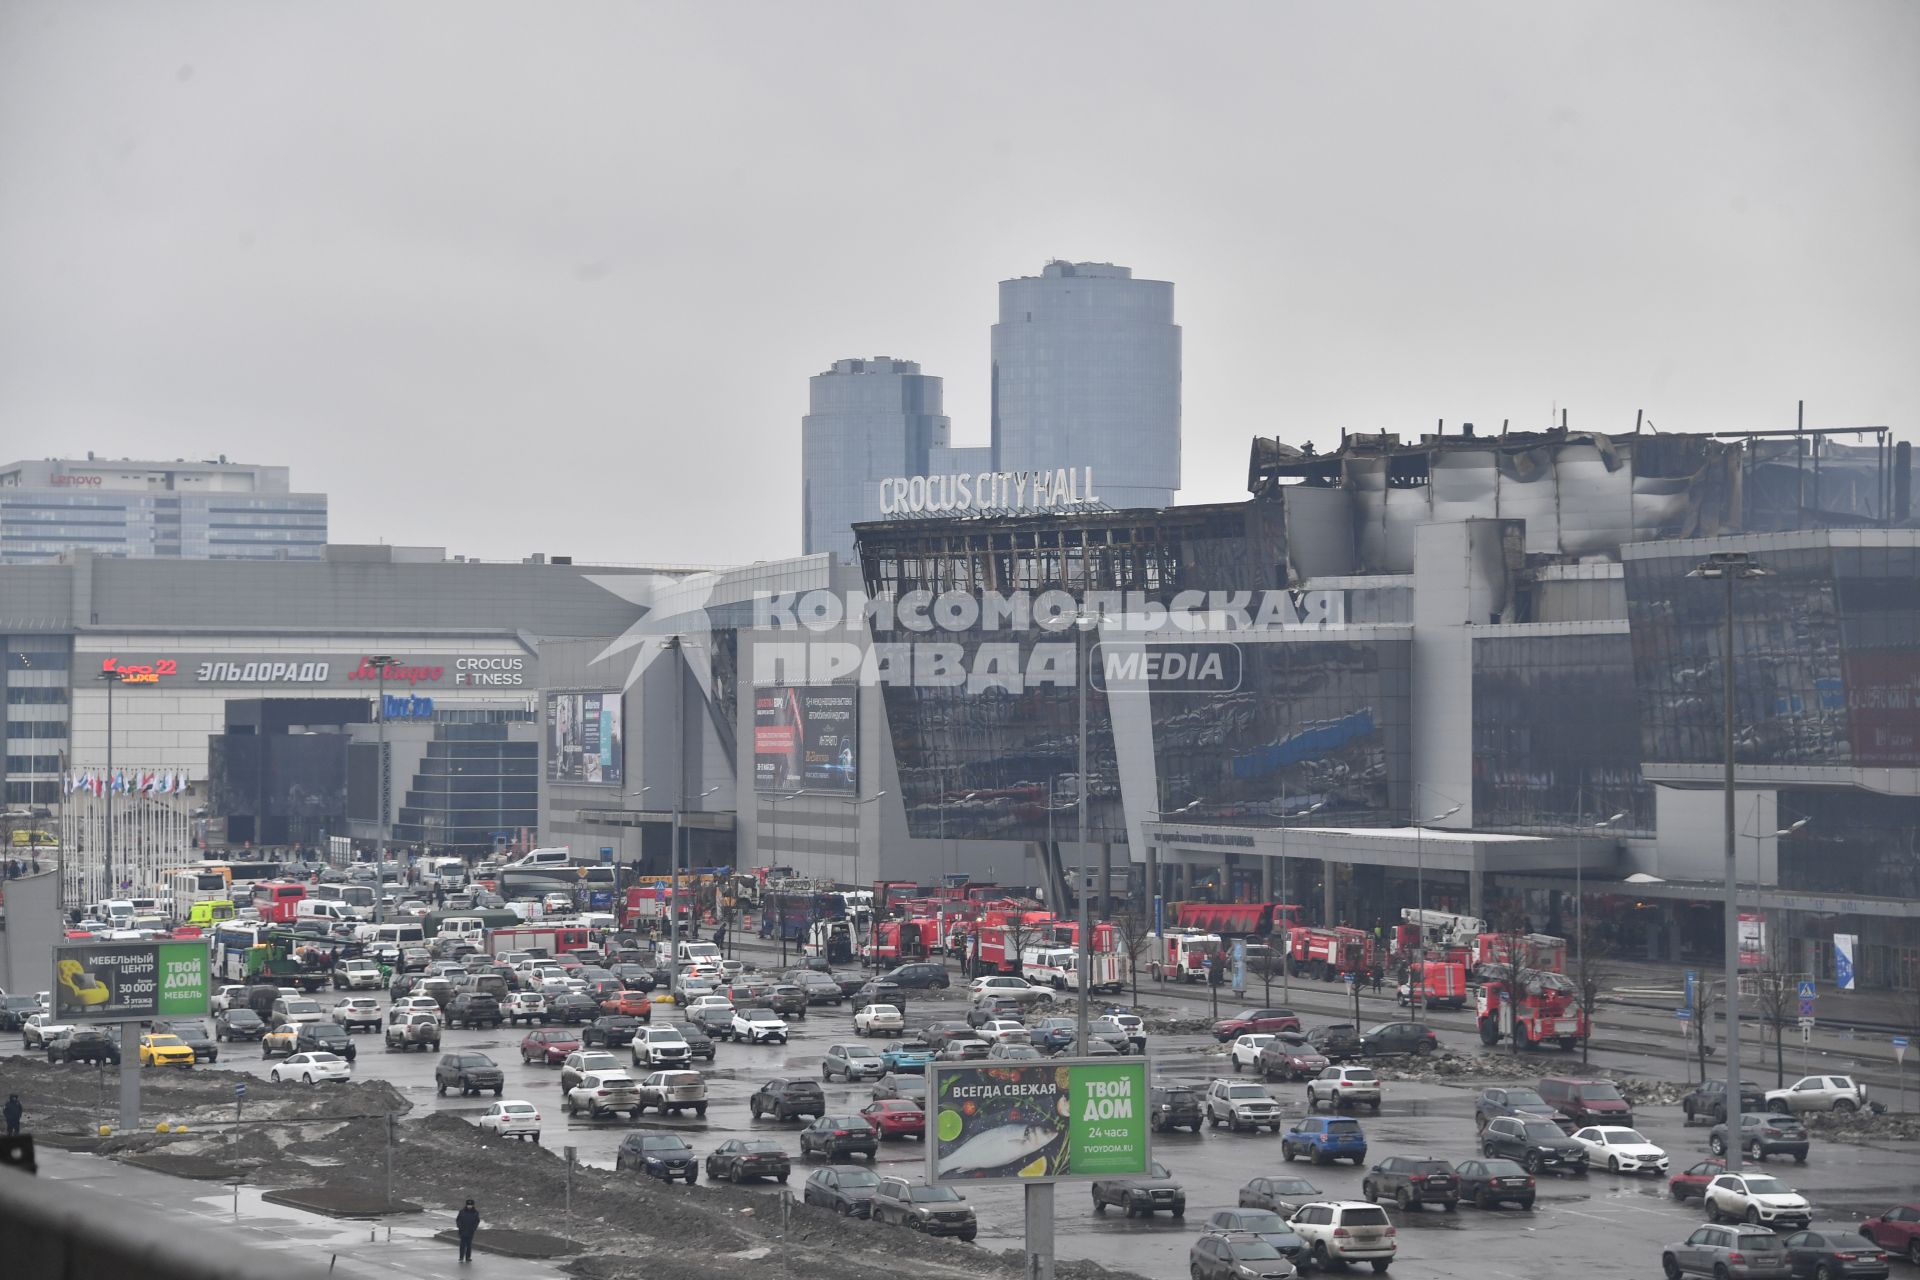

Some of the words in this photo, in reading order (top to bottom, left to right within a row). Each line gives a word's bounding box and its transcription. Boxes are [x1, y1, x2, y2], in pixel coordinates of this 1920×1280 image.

[50, 473, 102, 485] Lenovo
[880, 475, 972, 514] CROCUS
[976, 472, 1029, 510] CITY
[1033, 466, 1100, 507] HALL
[156, 659, 177, 675] 22
[455, 658, 523, 670] CROCUS
[197, 662, 329, 681] ЭЛЬДОРАДО
[89, 953, 153, 965] МЕБЕЛЬНЫЙ
[166, 958, 200, 972] ТВОЙ
[121, 965, 153, 973] ЦЕНТР
[164, 973, 201, 988] ДОМ
[119, 984, 132, 992] 30
[123, 995, 130, 1004] 3
[164, 991, 202, 999] МЕБЕЛЬ
[952, 1084, 1001, 1098] ВСЕГДА
[1003, 1083, 1057, 1096] СВЕЖАЯ
[1085, 1076, 1131, 1098] ТВОЙ
[1083, 1099, 1133, 1121] ДОМ
[1088, 1127, 1102, 1138] 24
[1104, 1128, 1129, 1138] часа
[1083, 1144, 1134, 1154] TVOYDOM.RU
